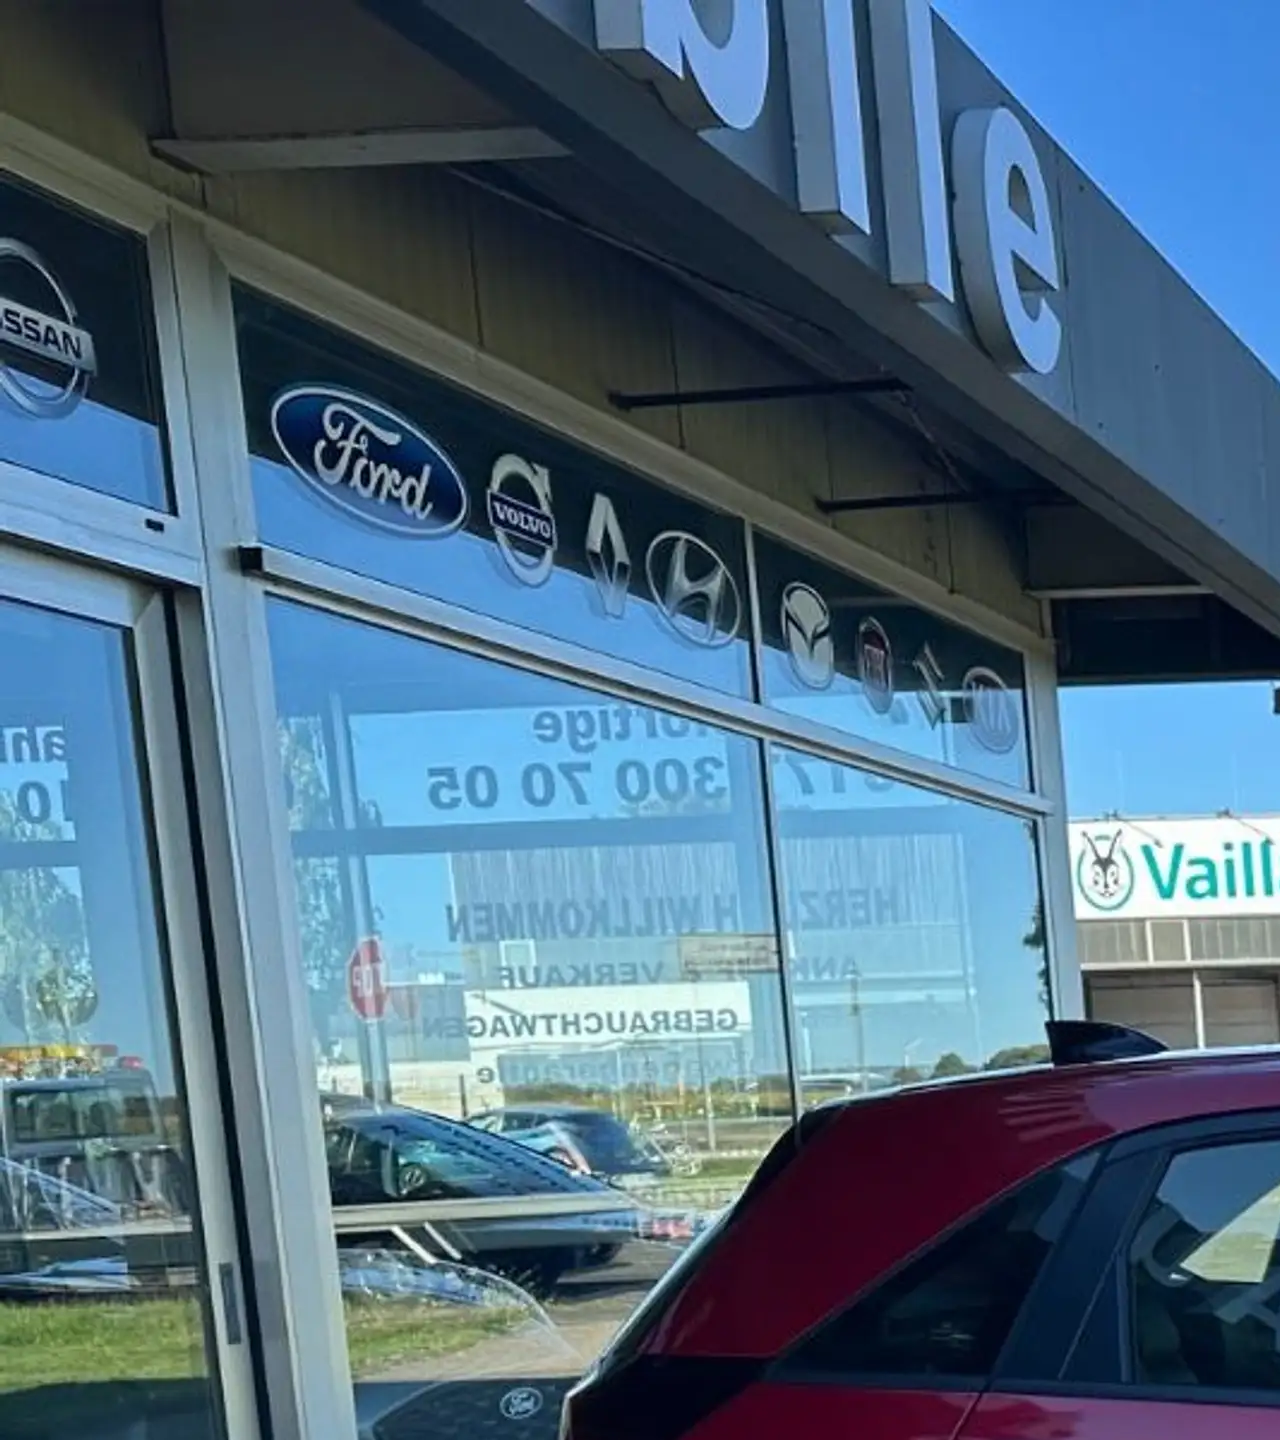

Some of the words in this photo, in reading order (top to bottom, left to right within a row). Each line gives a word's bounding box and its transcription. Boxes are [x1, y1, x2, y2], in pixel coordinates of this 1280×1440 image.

[0, 306, 82, 360] SSAN
[314, 402, 432, 521] Ford
[492, 500, 552, 539] VOLVO
